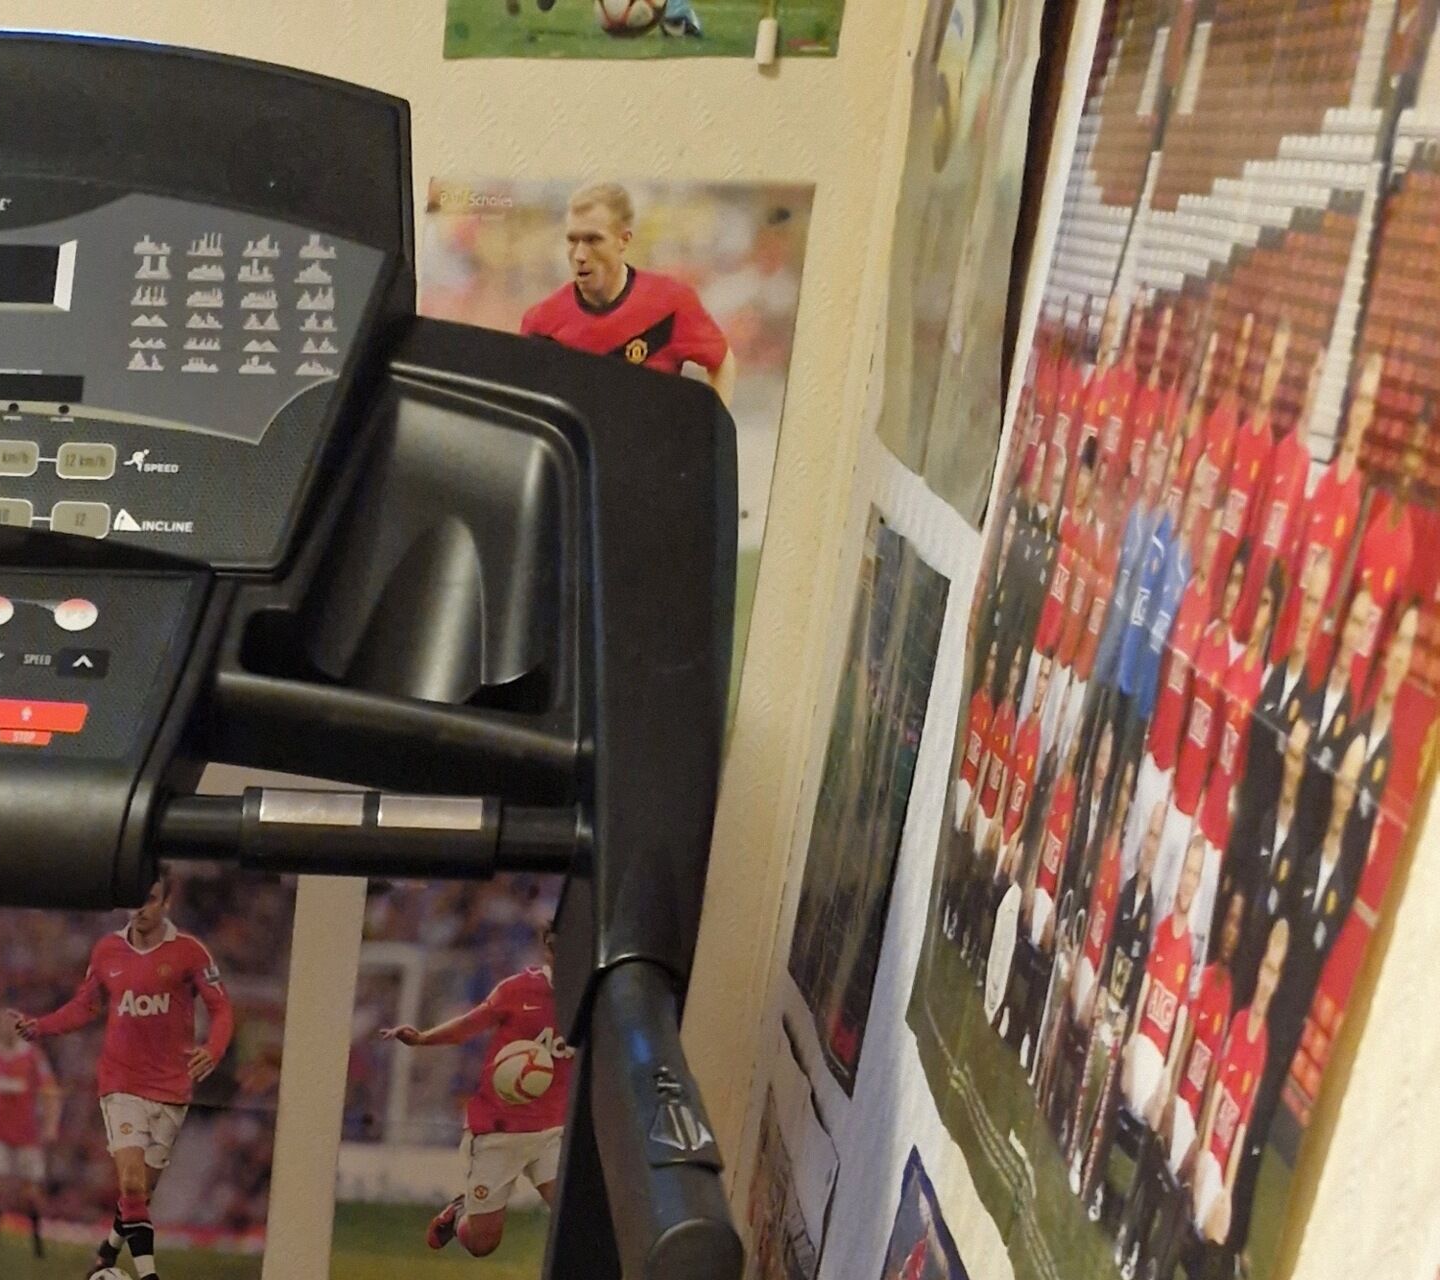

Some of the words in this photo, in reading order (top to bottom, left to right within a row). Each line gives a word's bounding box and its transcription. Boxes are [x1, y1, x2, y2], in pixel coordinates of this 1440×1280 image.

[78, 452, 107, 469] km/h
[143, 463, 180, 474] SPEED
[142, 520, 194, 534] INCLINE
[23, 653, 52, 666] SPEED
[117, 990, 170, 1017] AON
